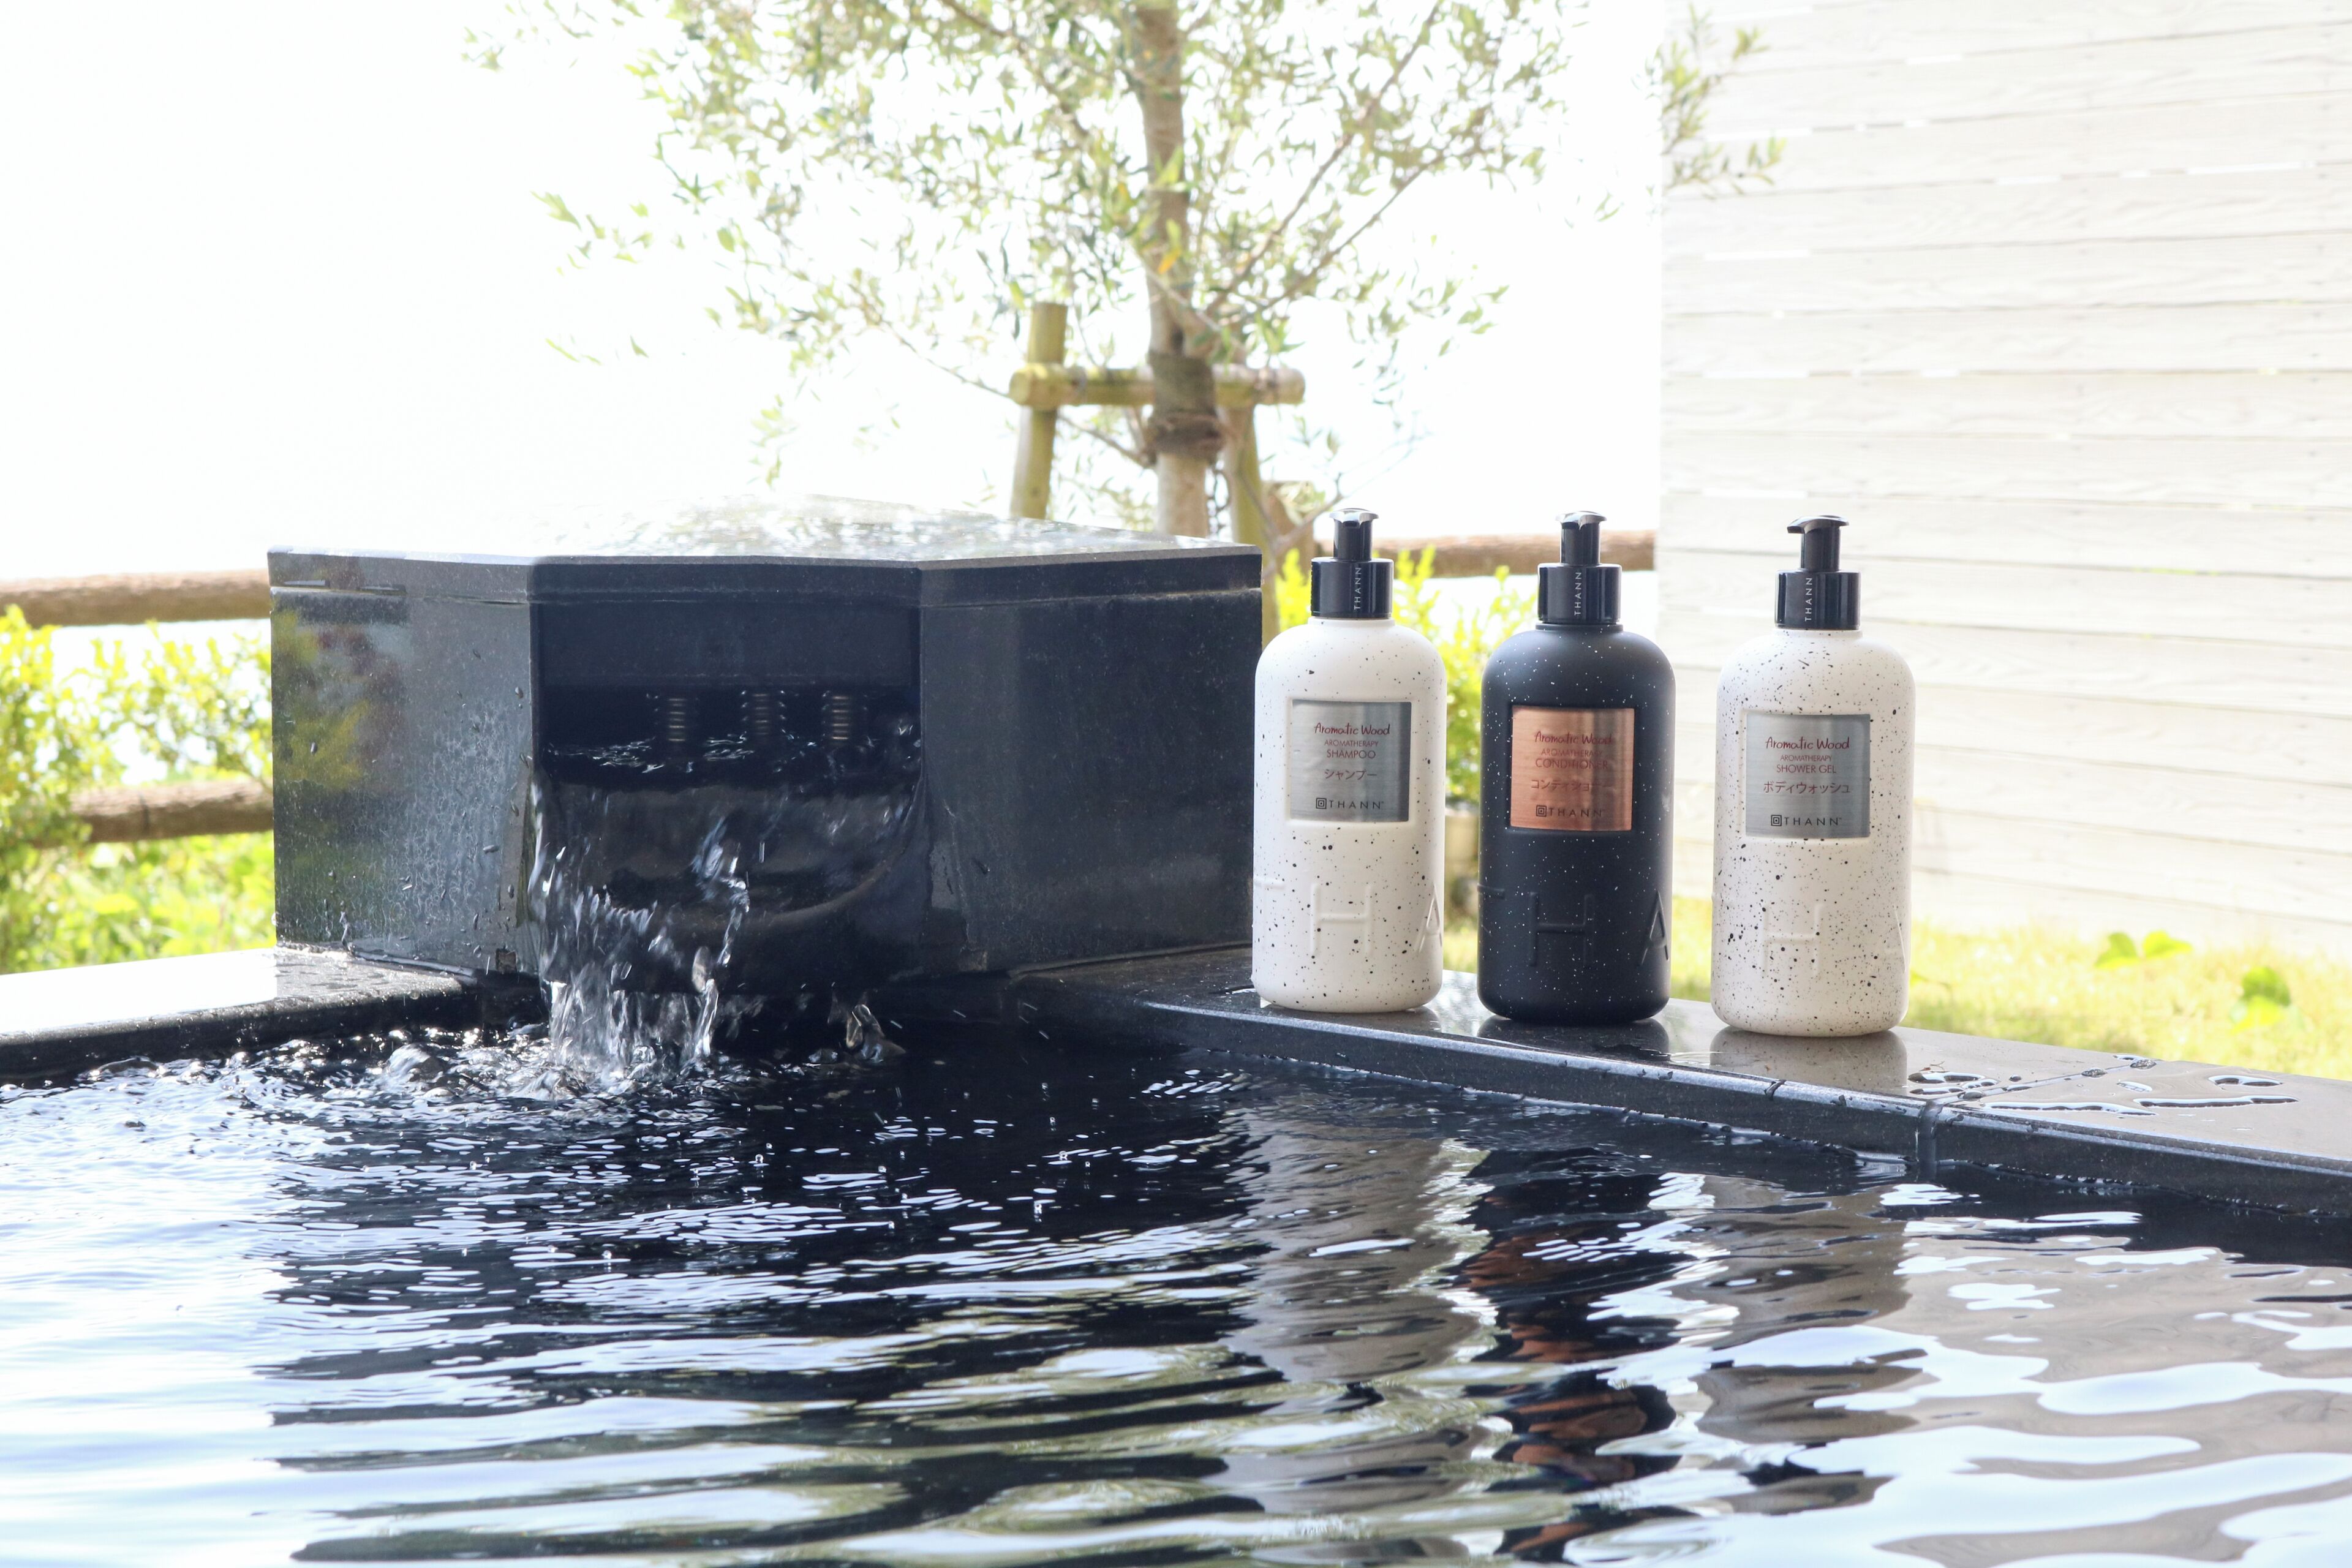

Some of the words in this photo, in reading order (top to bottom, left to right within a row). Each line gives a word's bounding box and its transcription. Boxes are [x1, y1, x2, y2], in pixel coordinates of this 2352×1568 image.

[1314, 722, 1359, 736] Aromatic
[1361, 723, 1390, 736] Wood
[1534, 731, 1578, 745] Aromatic
[1582, 733, 1613, 745] Wood
[1765, 736, 1814, 750] Aromatic
[1817, 736, 1850, 750] Wood
[1326, 750, 1376, 759] SHAMPOO
[1541, 748, 1603, 758] AROMATHERAPY
[1535, 758, 1608, 770] CONDITIONER
[1776, 764, 1816, 774] SHOWER
[1819, 764, 1837, 774] GEL
[1763, 780, 1851, 794] ボディウォッシュ
[1329, 800, 1381, 809] THANN
[1548, 808, 1602, 817] THANN
[1784, 817, 1838, 826] THANN
